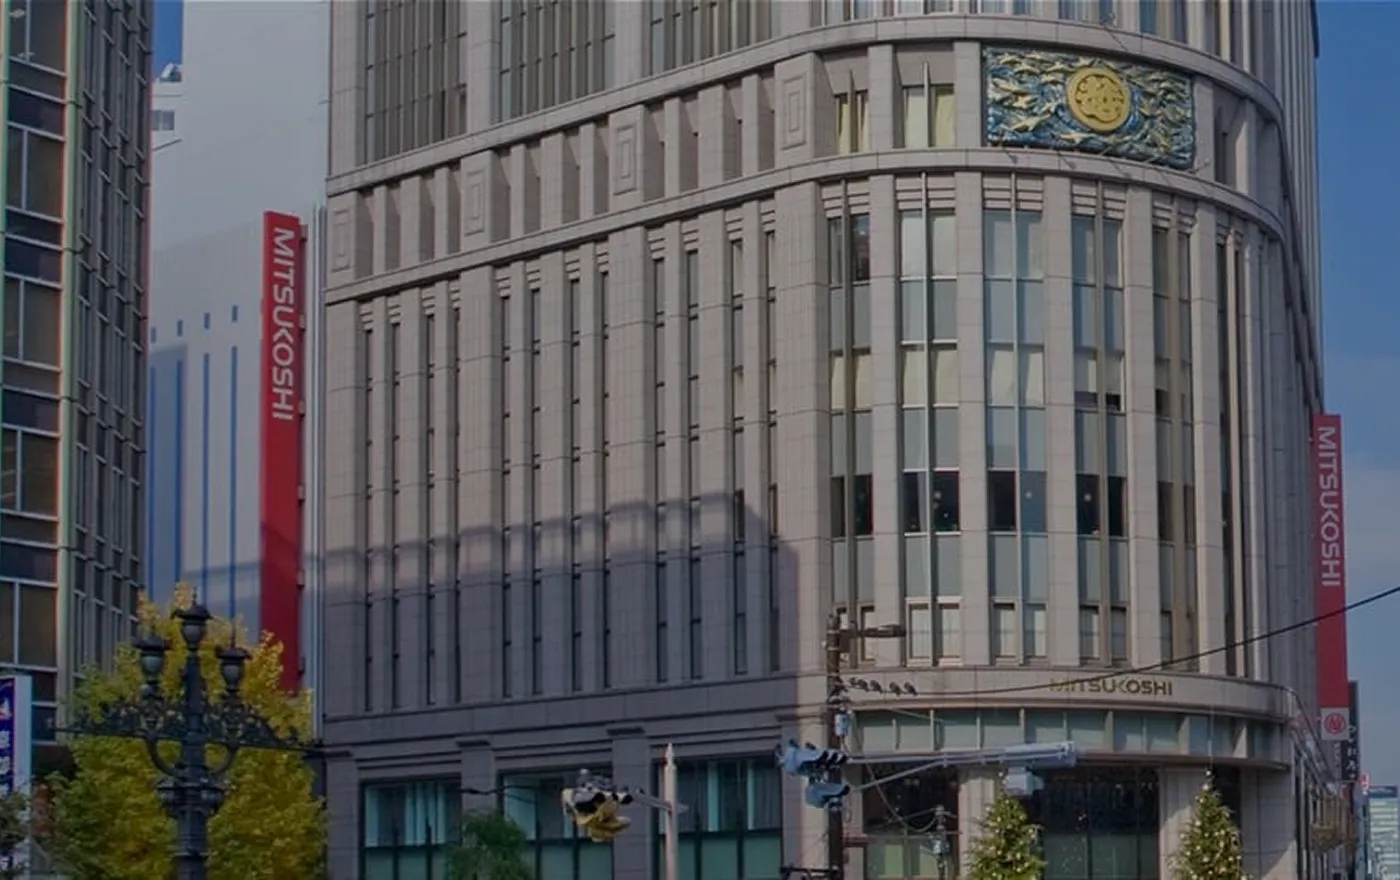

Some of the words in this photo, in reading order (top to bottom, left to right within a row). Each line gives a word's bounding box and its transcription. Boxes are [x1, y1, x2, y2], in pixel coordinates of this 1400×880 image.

[272, 227, 295, 421] MITSUKOSHI
[1318, 426, 1341, 587] MITSUKOSHI
[1050, 676, 1173, 696] MITSUKOSHI
